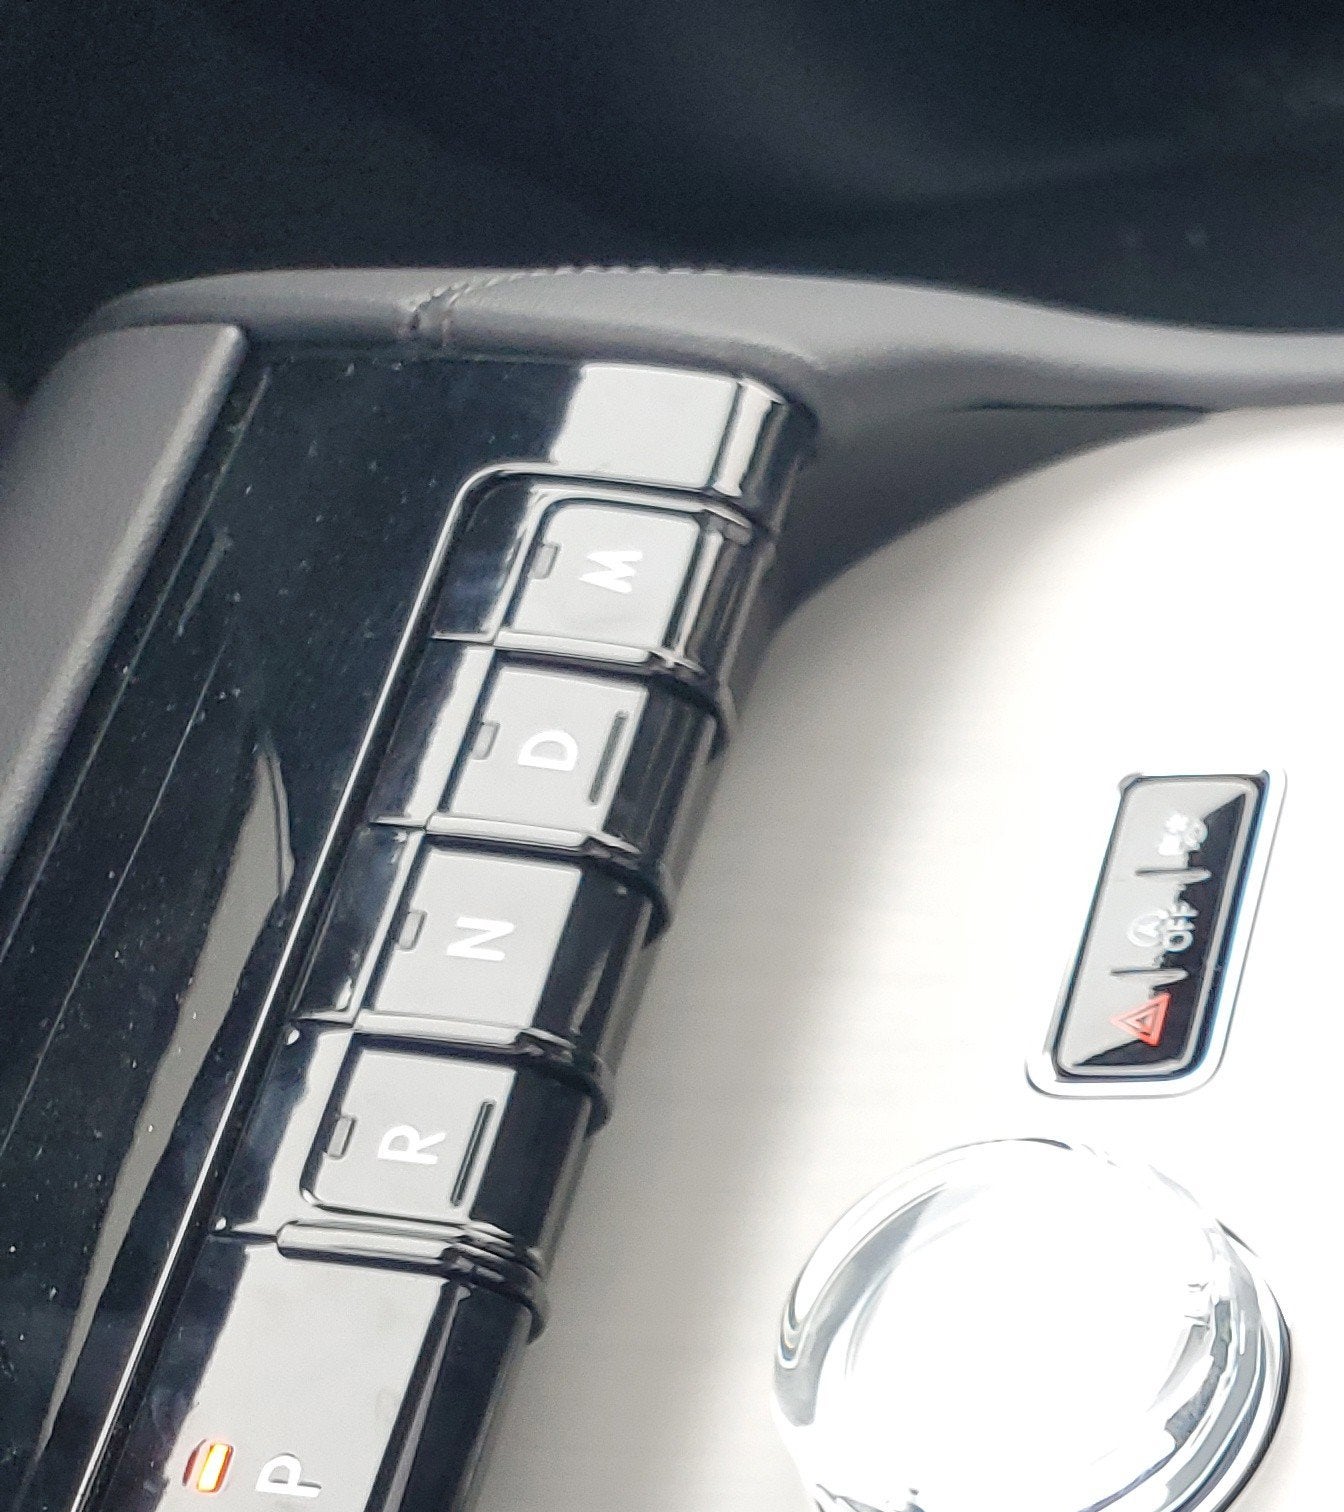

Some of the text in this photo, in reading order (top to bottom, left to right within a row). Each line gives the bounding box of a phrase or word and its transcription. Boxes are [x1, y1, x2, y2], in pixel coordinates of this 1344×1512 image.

[579, 549, 644, 594] M
[517, 729, 580, 772] D
[446, 916, 516, 962] N
[377, 1123, 448, 1166] R
[255, 1452, 323, 1499] P
